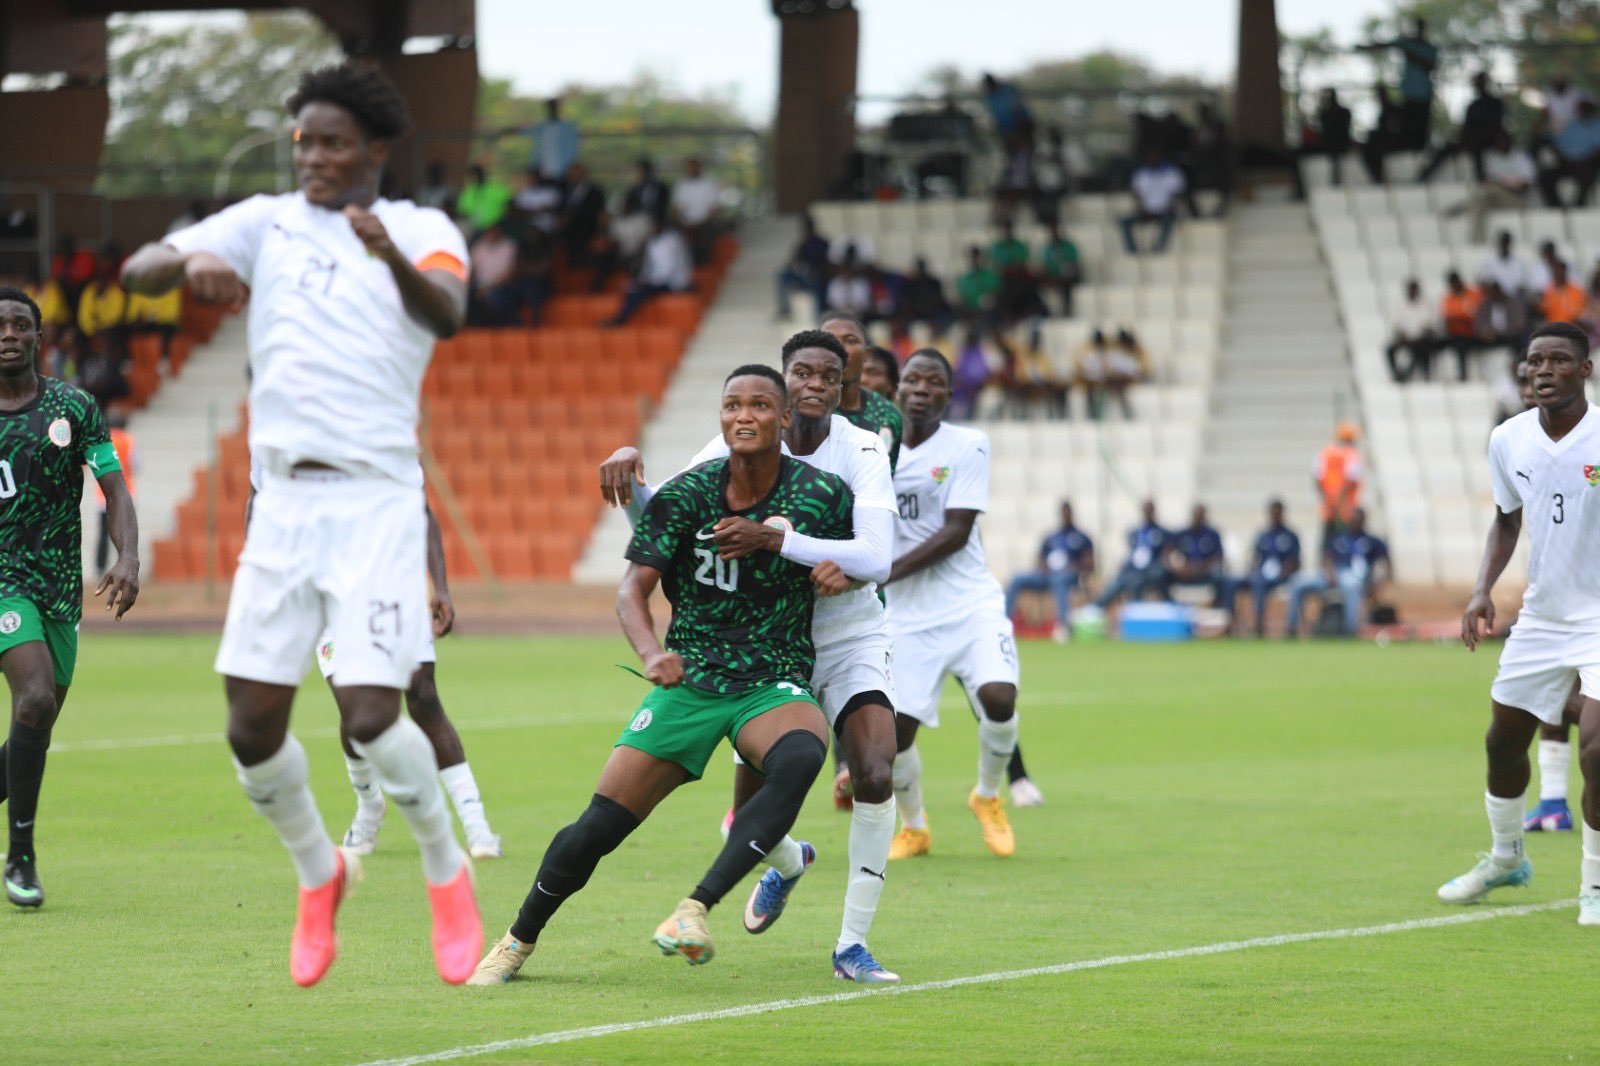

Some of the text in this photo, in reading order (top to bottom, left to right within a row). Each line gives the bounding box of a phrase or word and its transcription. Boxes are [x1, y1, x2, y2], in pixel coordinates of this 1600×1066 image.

[896, 493, 919, 520] 20
[1552, 493, 1564, 524] 3
[693, 547, 738, 592] 20
[369, 600, 402, 637] 21
